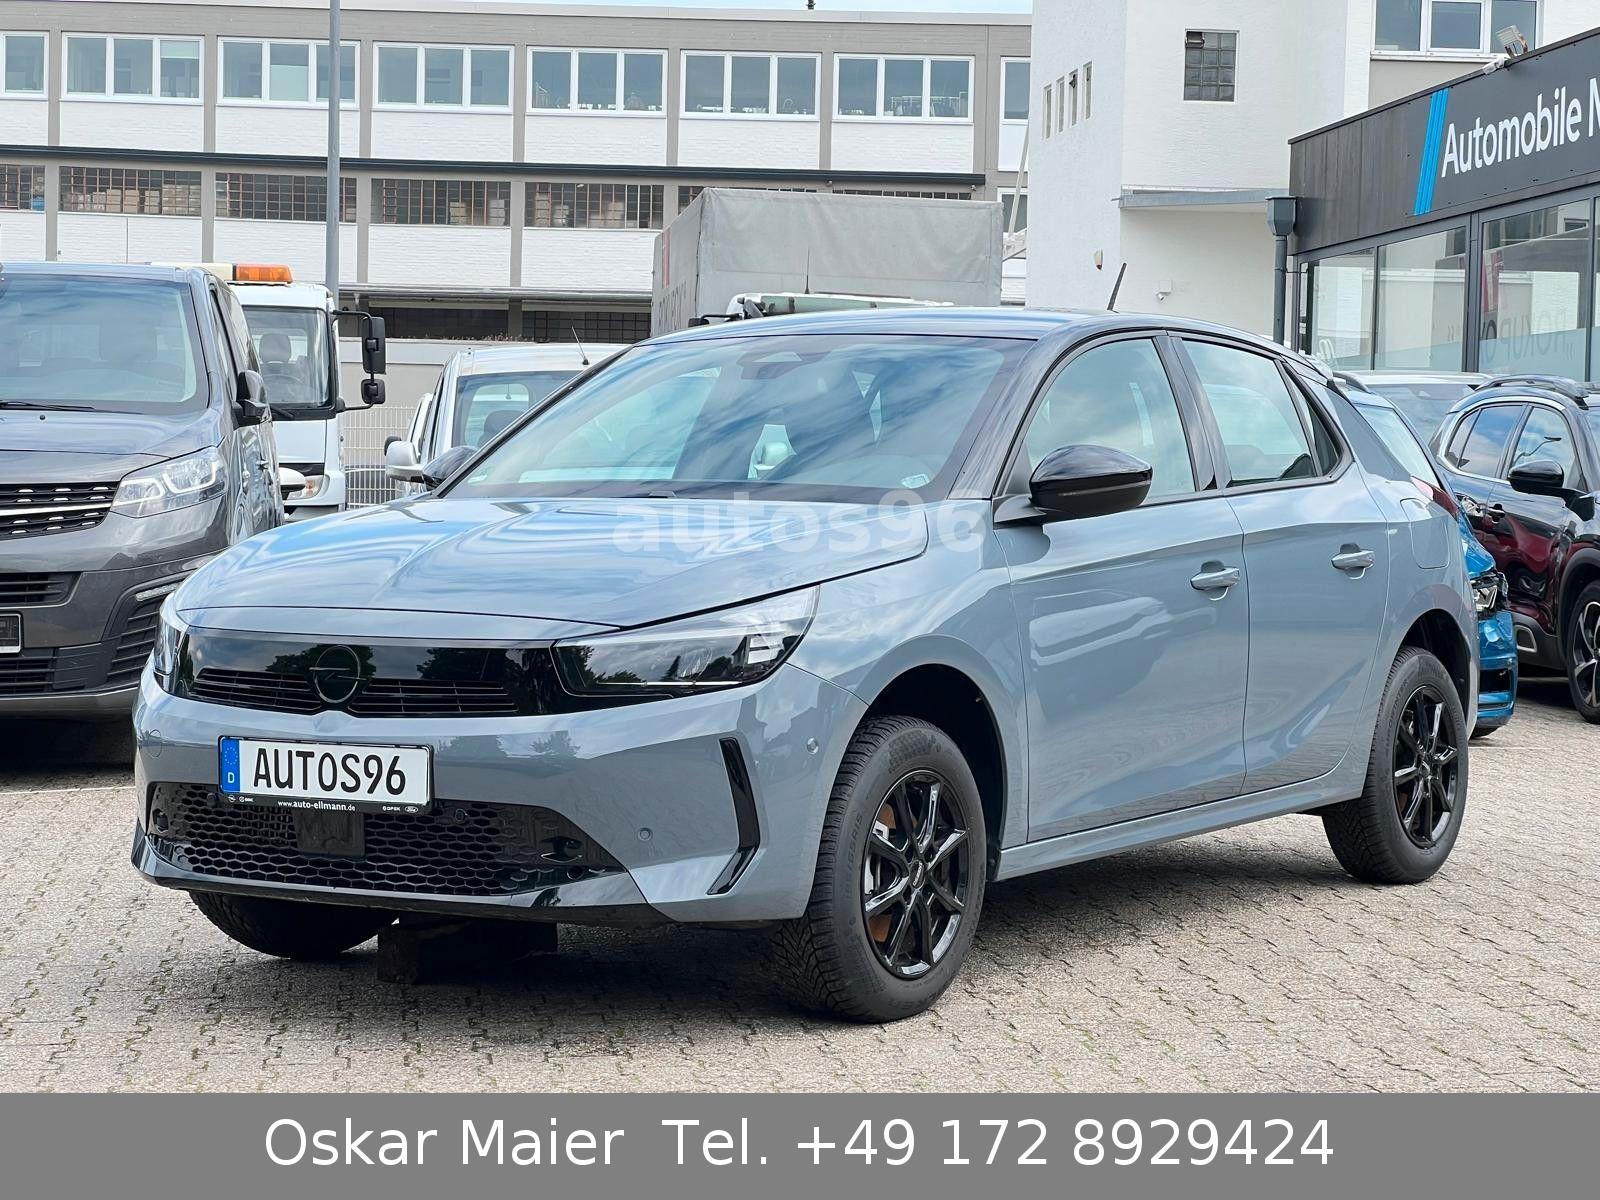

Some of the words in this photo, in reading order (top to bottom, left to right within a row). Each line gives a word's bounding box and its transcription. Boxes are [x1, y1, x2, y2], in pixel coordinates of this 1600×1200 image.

[1441, 86, 1583, 178] Automobile
[227, 772, 235, 784] D
[253, 747, 406, 796] AUTOS96
[277, 800, 356, 811] www.auto-ellmann.de
